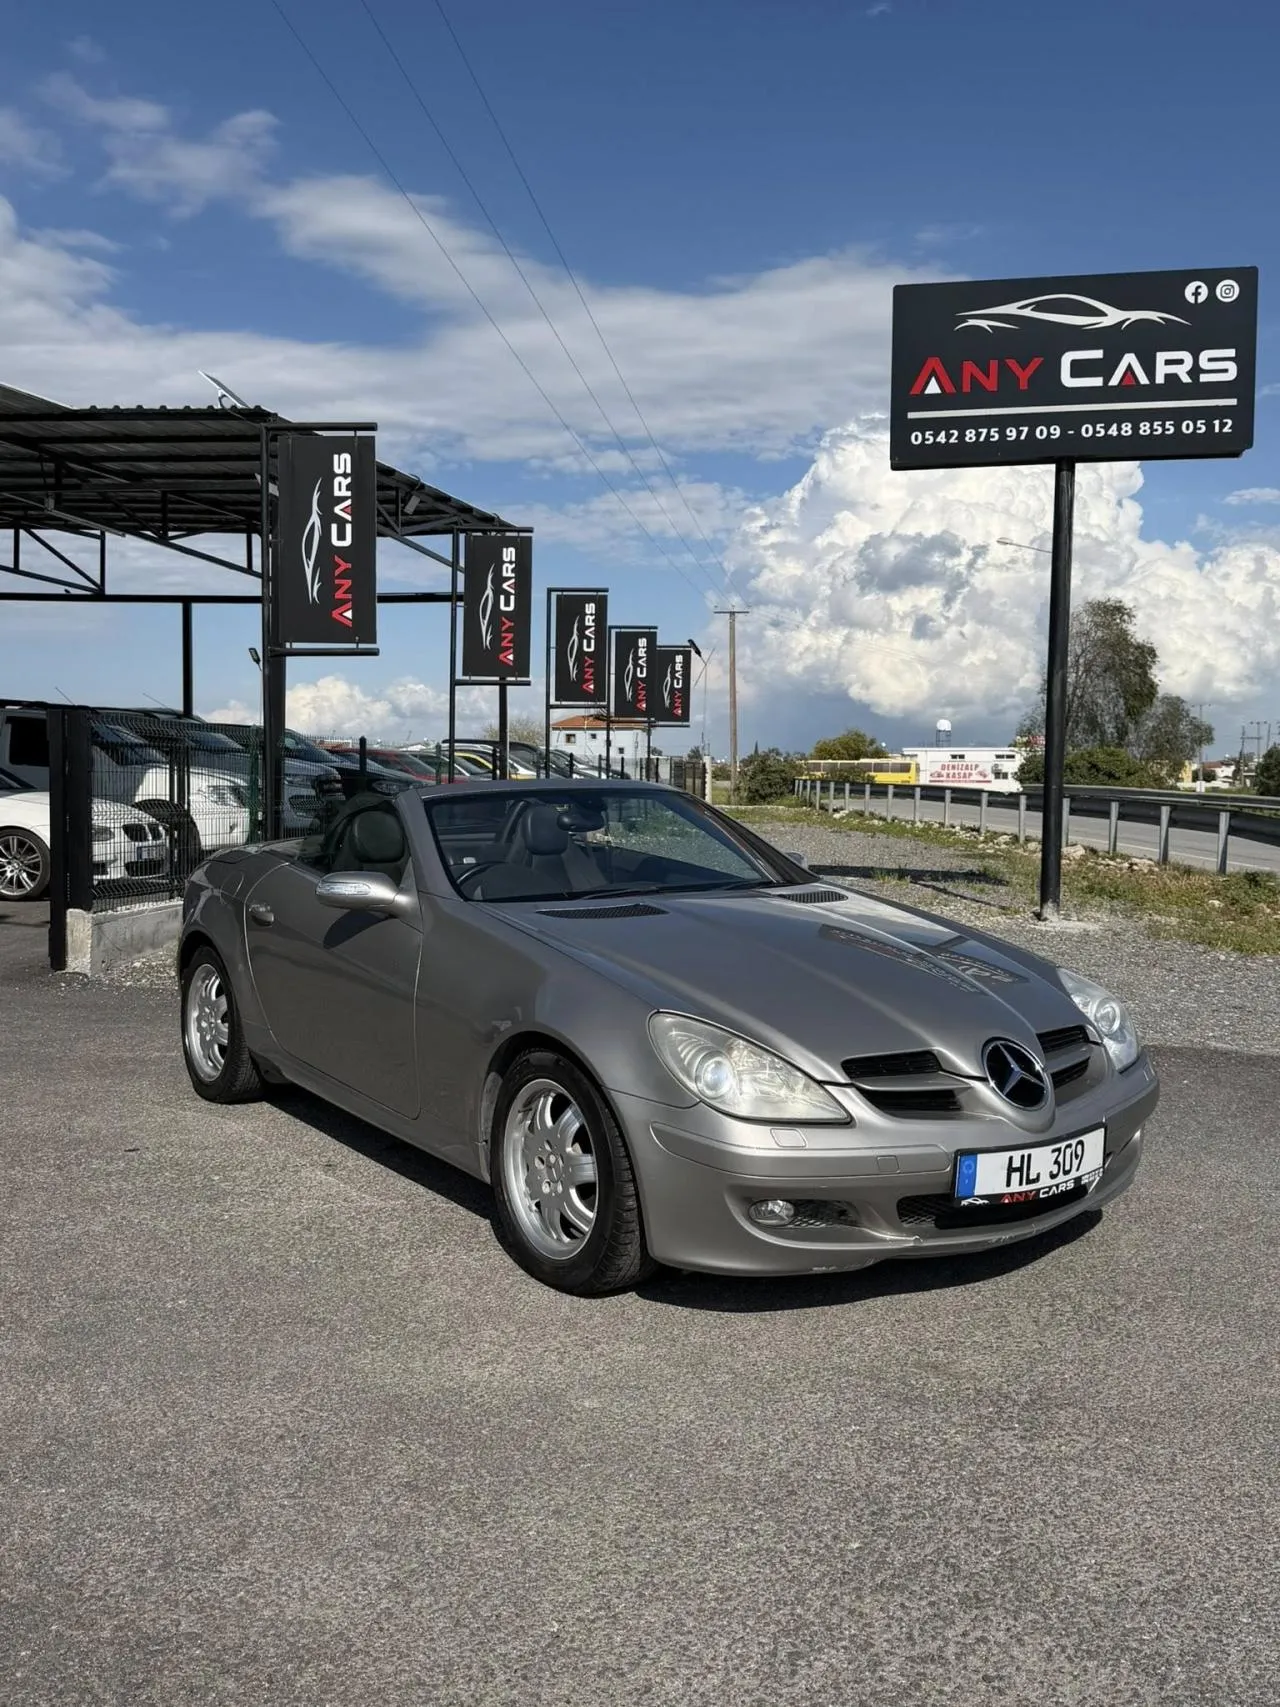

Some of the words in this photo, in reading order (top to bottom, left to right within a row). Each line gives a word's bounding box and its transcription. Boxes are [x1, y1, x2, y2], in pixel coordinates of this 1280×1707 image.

[909, 356, 1044, 395] ANY
[1060, 348, 1238, 388] CARS
[911, 429, 959, 445] 0542
[965, 427, 999, 443] 875
[1006, 426, 1029, 441] 97
[1036, 424, 1061, 439] 09
[1081, 422, 1133, 438] 0548
[1140, 420, 1175, 436] 855
[1181, 419, 1207, 434] 05
[1213, 418, 1233, 434] 12
[331, 452, 352, 547] CARS
[331, 554, 353, 628] ANY
[500, 547, 516, 612] CARS
[498, 616, 515, 666] ANY
[583, 602, 596, 652] CARS
[581, 656, 595, 693] ANY
[637, 637, 647, 678] CARS
[674, 654, 683, 689] CARS
[636, 680, 647, 712] ANY
[672, 690, 683, 716] ANY
[1006, 1153, 1040, 1188] HL
[1050, 1139, 1085, 1180] 309
[1000, 1190, 1037, 1204] ANY
[1039, 1179, 1075, 1199] CARS
